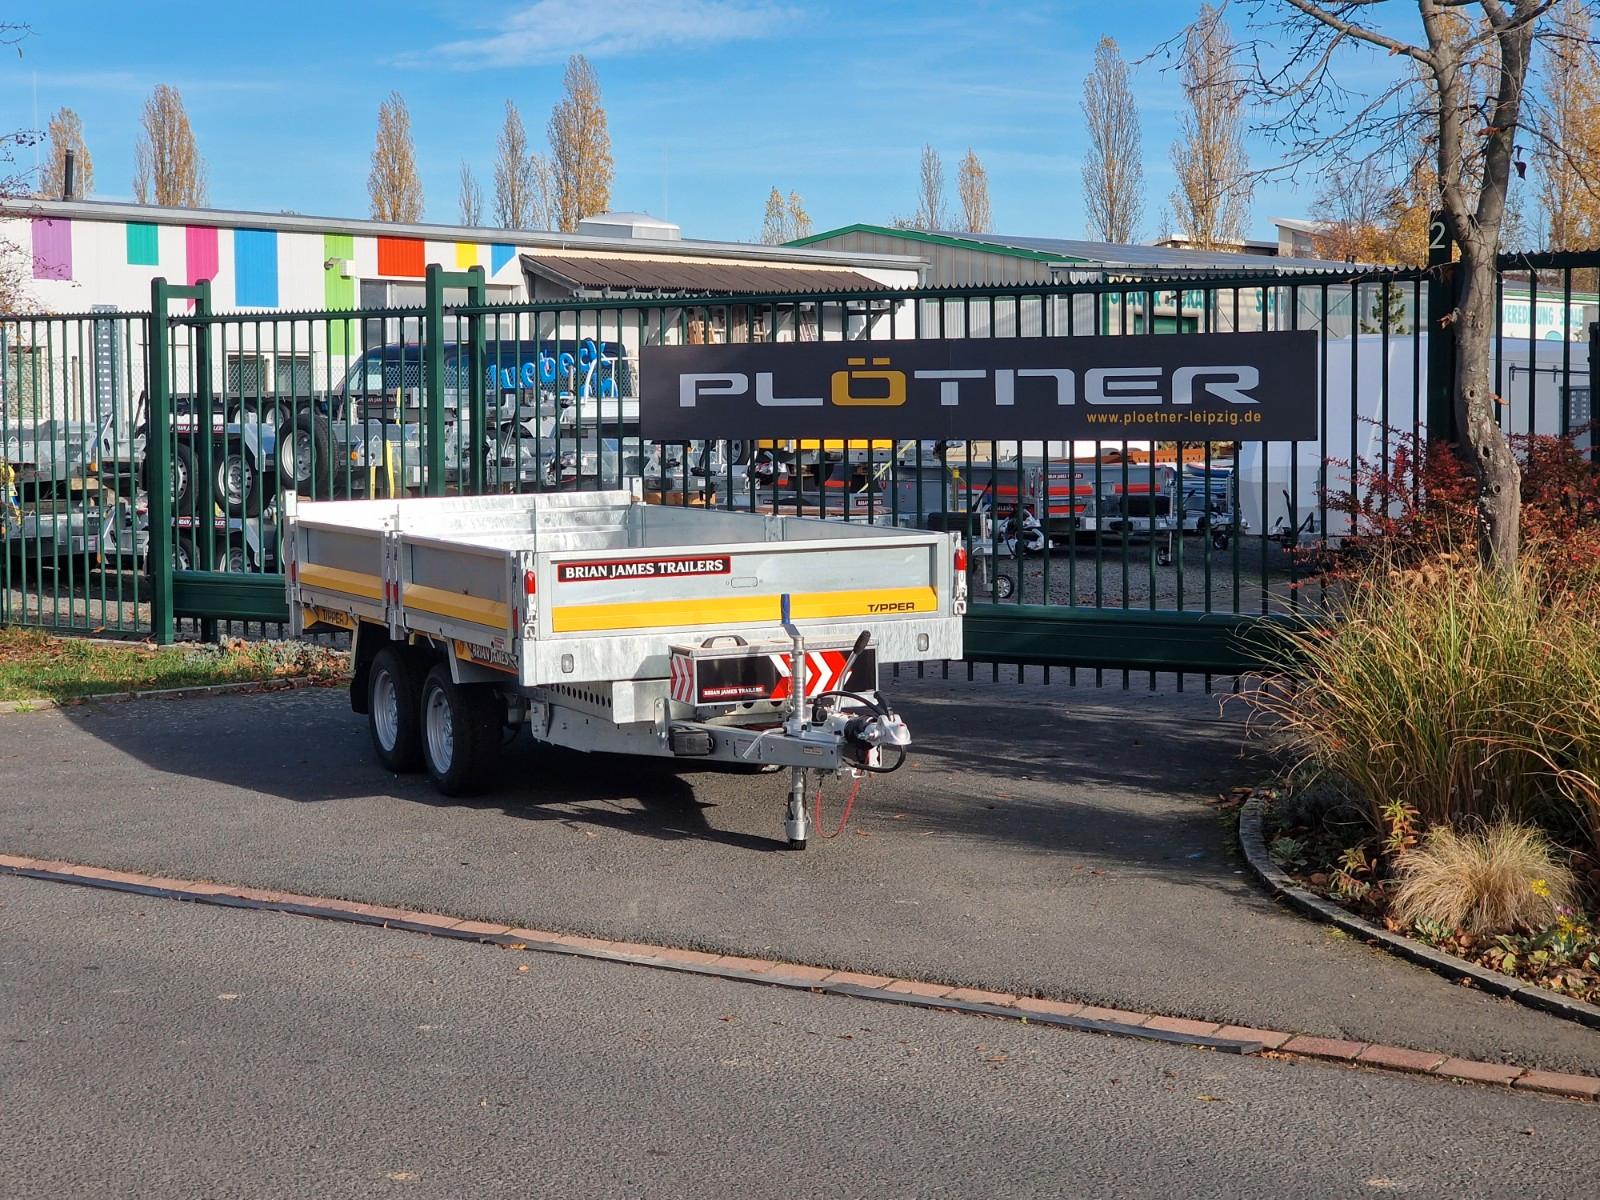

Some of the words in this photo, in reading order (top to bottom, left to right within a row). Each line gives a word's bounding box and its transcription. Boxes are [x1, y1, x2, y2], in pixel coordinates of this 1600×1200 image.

[1430, 221, 1446, 249] 2
[679, 358, 1261, 408] PLÖTNER
[1086, 410, 1262, 426] www.ploetner-leipzig.de
[565, 565, 608, 579] BRIAN
[609, 563, 655, 578] JAMES
[657, 559, 724, 574] TRAILERS
[472, 642, 490, 660] BRIAN
[489, 648, 509, 665] JAMES
